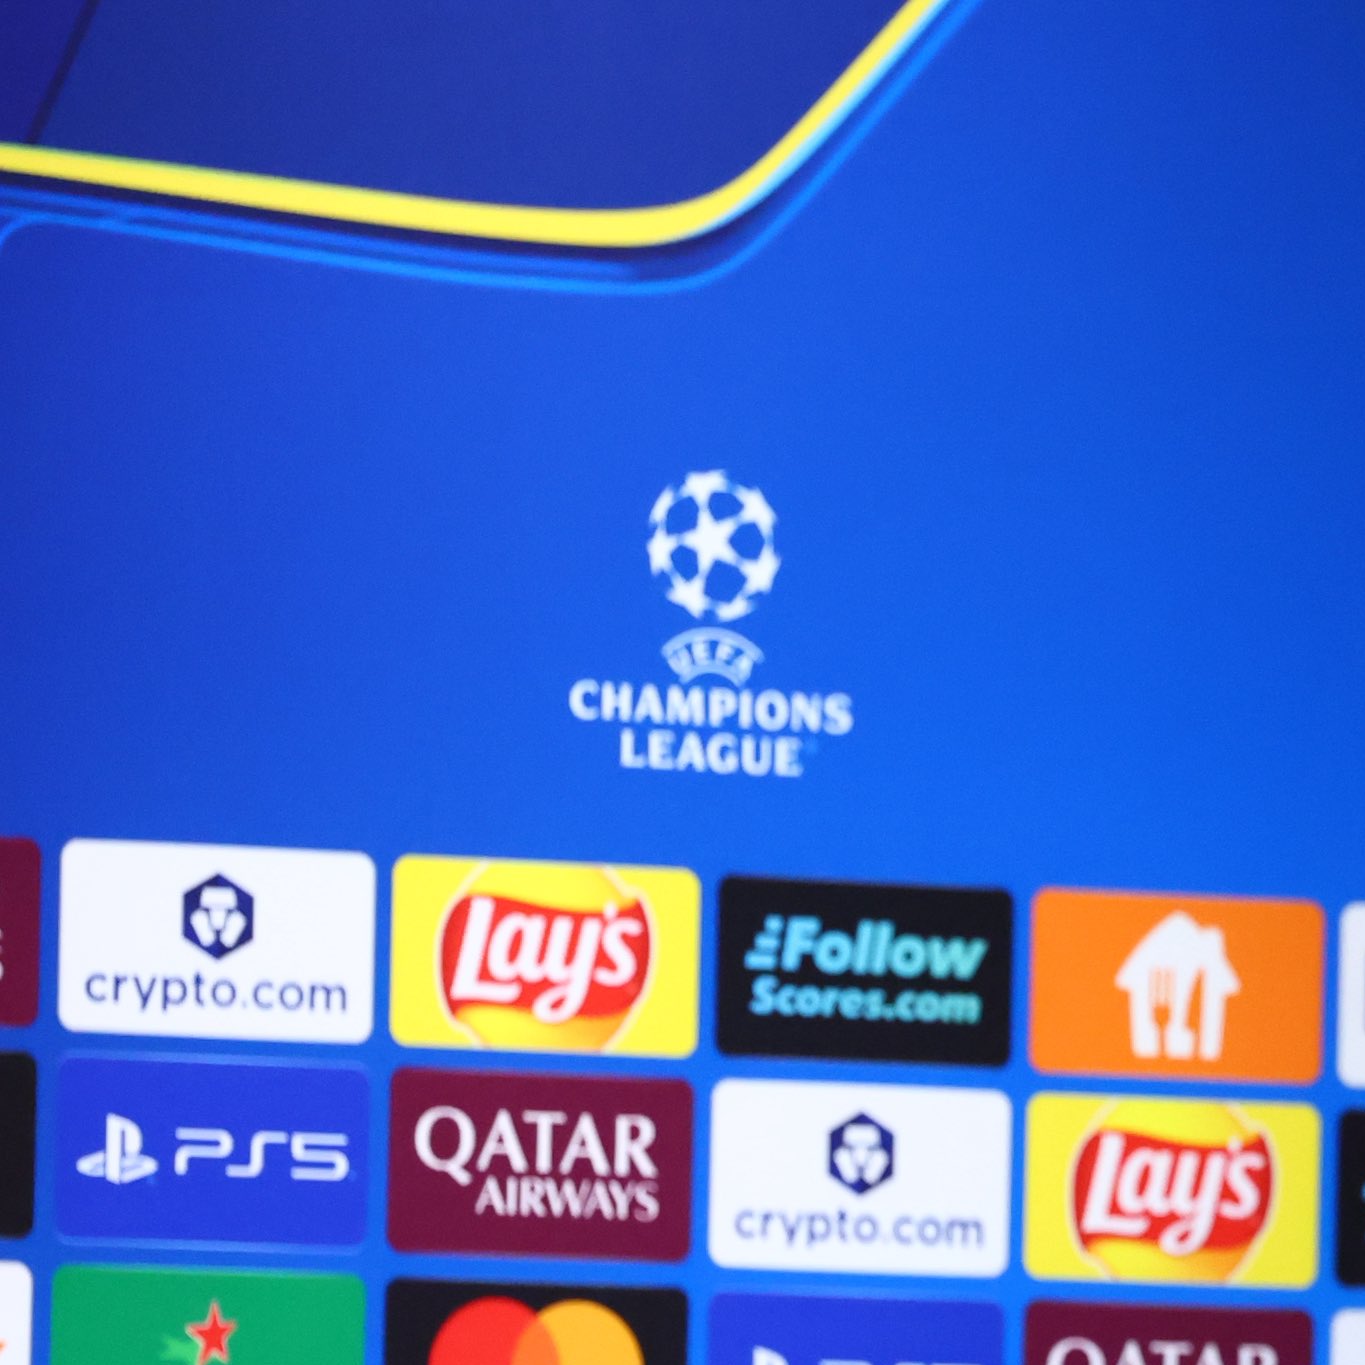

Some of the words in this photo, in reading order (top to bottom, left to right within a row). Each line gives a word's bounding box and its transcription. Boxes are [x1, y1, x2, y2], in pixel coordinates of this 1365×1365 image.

[568, 678, 853, 735] CHAMPIONS
[620, 728, 803, 777] LEAGUE
[449, 897, 641, 1023] Lay's
[781, 914, 988, 980] Follow
[86, 969, 347, 1013] crypto.com
[750, 974, 982, 1025] Scores.com
[174, 1126, 350, 1181] PS5
[414, 1105, 656, 1186] QATAR
[475, 1177, 659, 1221] AIRWAYS
[1082, 1132, 1264, 1256] Lay's
[734, 1208, 984, 1249] crypto.com
